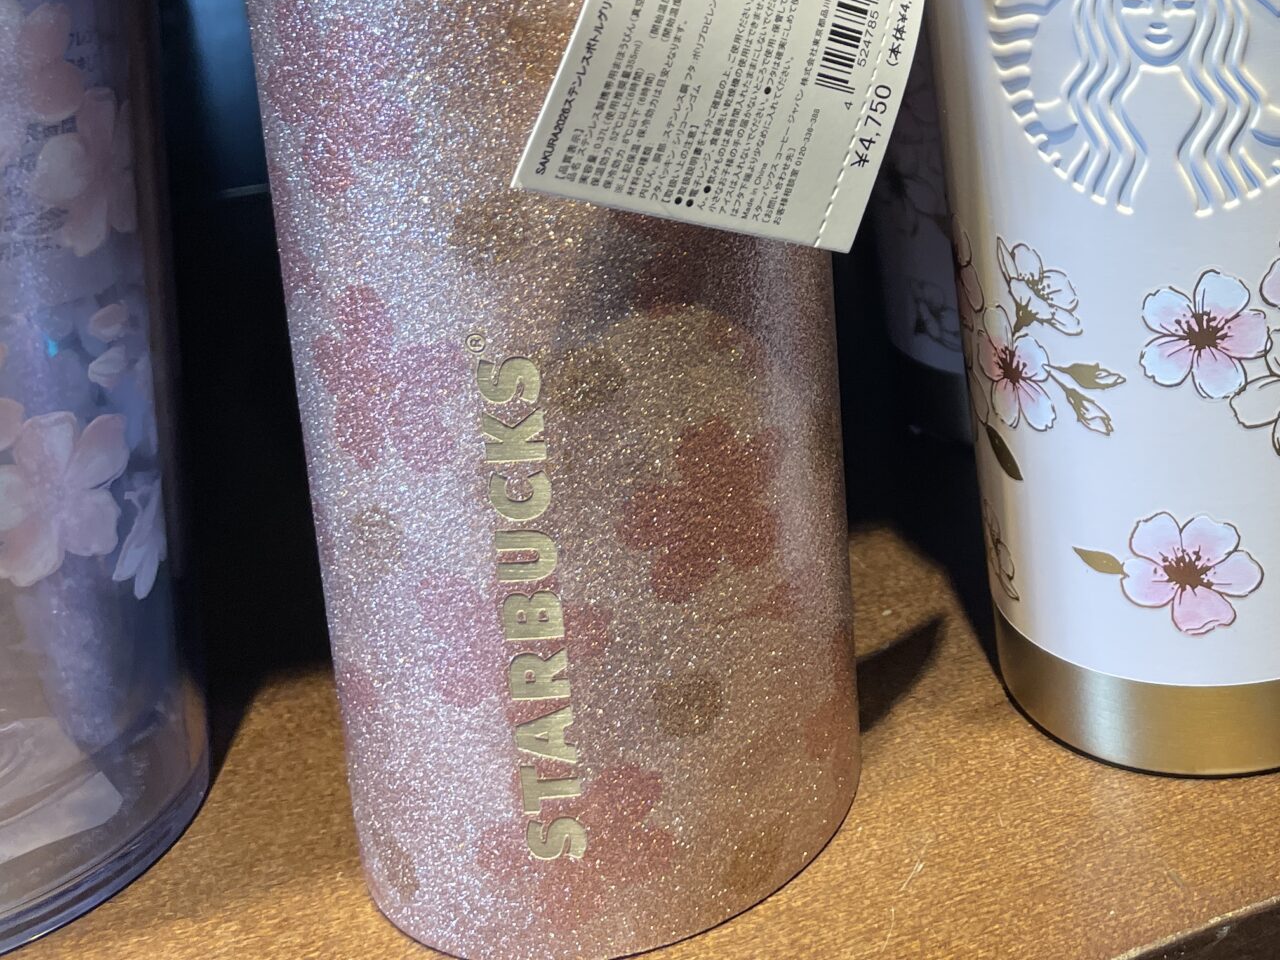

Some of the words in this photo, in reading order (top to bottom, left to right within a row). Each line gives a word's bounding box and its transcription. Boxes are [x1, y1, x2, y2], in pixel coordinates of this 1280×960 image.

[843, 100, 854, 111] 4
[855, 8, 880, 68] 524785
[850, 82, 893, 170] ¥4,750
[750, 186, 758, 195] in
[753, 161, 768, 186] China
[740, 196, 754, 219] Made
[476, 354, 587, 860] STARBUCKS
